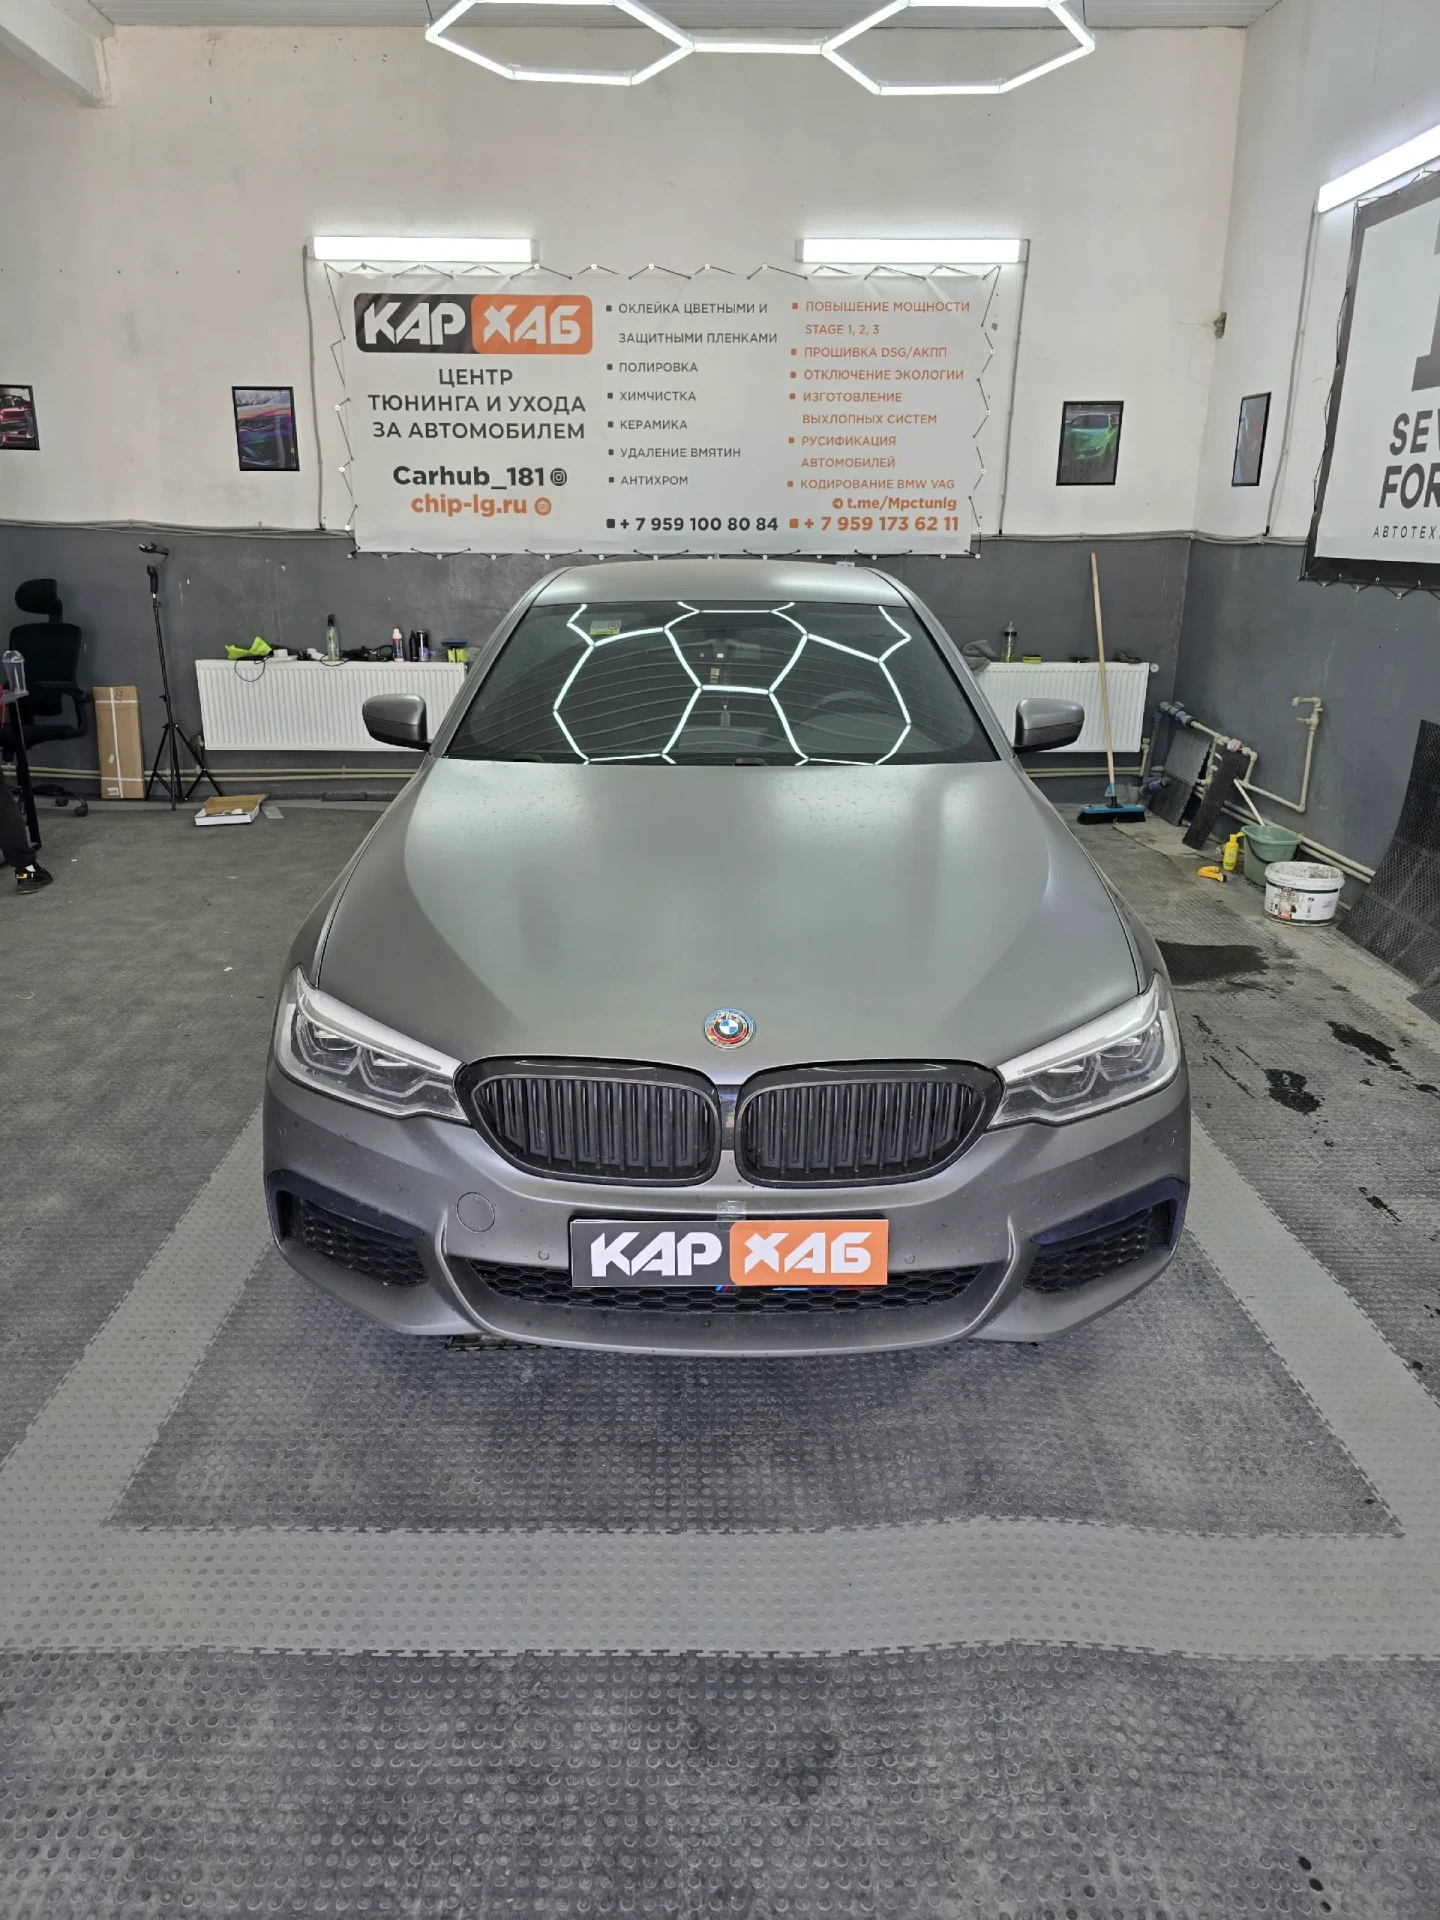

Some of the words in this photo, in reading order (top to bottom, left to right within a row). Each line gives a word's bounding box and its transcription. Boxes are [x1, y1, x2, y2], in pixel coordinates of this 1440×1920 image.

[619, 302, 680, 314] ОКЛЕЙКА
[684, 304, 755, 315] ЦВЕТНЫМИ
[758, 304, 768, 313] И
[805, 302, 889, 312] ПОВЫШЕНИЕ
[893, 302, 970, 314] МОЩНОСТИ
[364, 302, 466, 345] КАР
[483, 305, 581, 344] ХАБ
[805, 325, 843, 335] STAGE
[873, 325, 879, 335] 3
[619, 333, 703, 344] ЗАЩИТНЫМИ
[707, 333, 777, 343] ПЛЕНКАМИ
[804, 347, 876, 357] ПРОШИВКА
[881, 347, 947, 359] DSG/АКПП
[619, 362, 698, 372] ПОЛИРОВКА
[439, 369, 513, 387] ЦЕНТР
[804, 370, 891, 380] ОТКЛЮЧЕНИЕ
[895, 370, 964, 380] ЭКОЛОГИИ
[620, 391, 696, 401] ХИМЧИСТКА
[803, 392, 902, 402] ИЗГОТОВЛЕНИЕ
[368, 394, 479, 412] ТЮНИНГА
[487, 396, 501, 412] И
[508, 396, 586, 414] УХОДА
[620, 420, 687, 430] КЕРАМИКА
[803, 414, 883, 424] ВЫХЛОПНЫХ
[887, 414, 937, 424] СИСТЕМ
[373, 423, 402, 439] ЗА
[408, 423, 585, 440] АВТОМОБИЛЕМ
[1390, 409, 1440, 456] SE
[802, 436, 896, 447] РУСИФИКАЦИЯ
[620, 448, 687, 459] УДАЛЕНИЕ
[691, 448, 741, 457] ВМЯТИН
[801, 456, 895, 467] АВТОМОБИЛЕЙ
[393, 466, 544, 489] Carhub_181
[621, 476, 688, 485] АНТИХРОМ
[800, 479, 893, 491] КОДИРОВАНИЕ
[897, 479, 927, 489] BMW
[931, 479, 955, 489] VAG
[411, 494, 527, 517] chip-lg.ru
[635, 518, 646, 531] 7
[651, 518, 684, 531] 959
[689, 518, 723, 531] 100
[727, 518, 750, 531] 80
[756, 518, 778, 531] 84
[821, 517, 831, 530] 7
[837, 517, 872, 530] 959
[880, 517, 909, 530] 173
[914, 517, 938, 530] 62
[944, 517, 958, 530] 11
[1373, 526, 1440, 539] АВТОТЕХ
[591, 1232, 722, 1277] КАР
[744, 1232, 872, 1275] ХАБ
